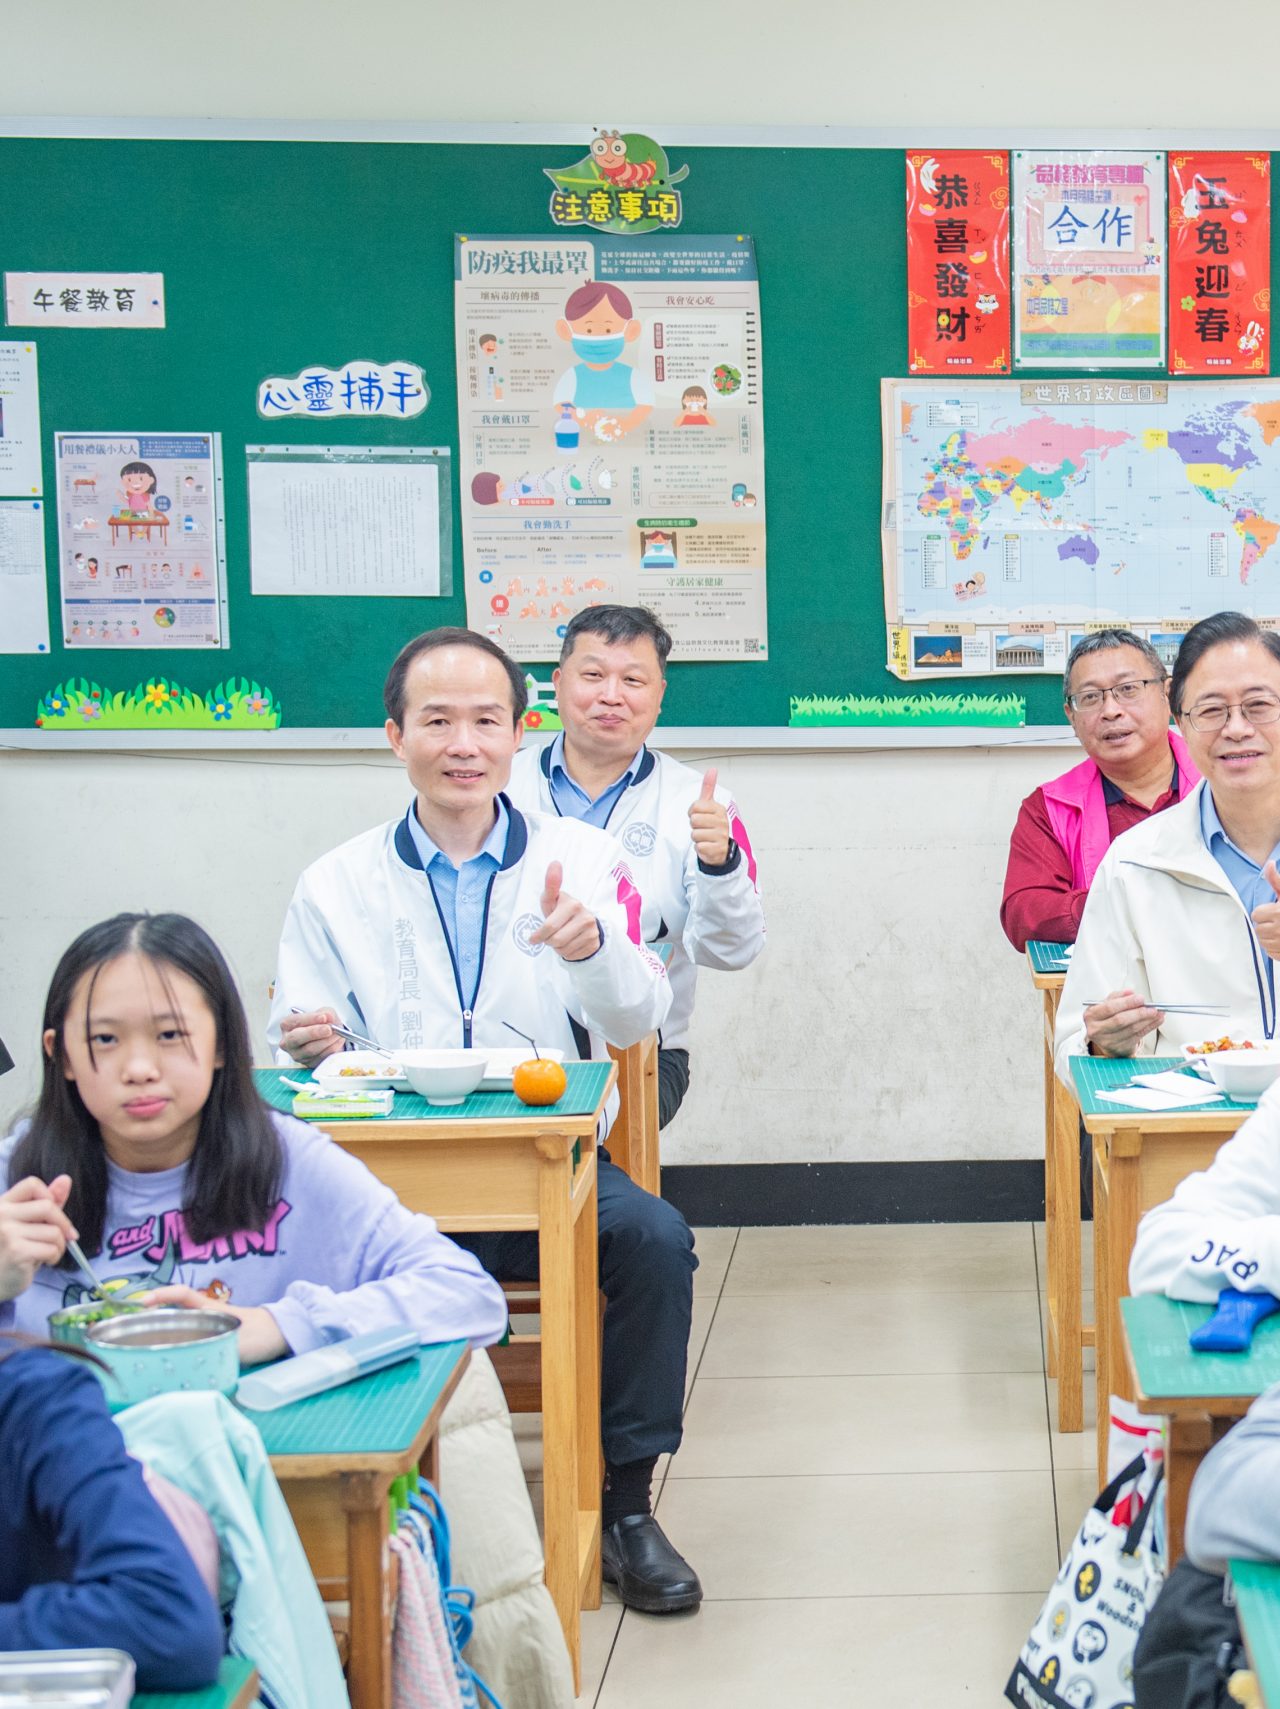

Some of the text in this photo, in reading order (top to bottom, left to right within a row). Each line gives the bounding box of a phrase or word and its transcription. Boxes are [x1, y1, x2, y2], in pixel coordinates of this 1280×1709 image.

[553, 191, 678, 222] 注意事項
[1047, 204, 1133, 247] 合作
[467, 250, 589, 275] 防疫我最罩
[934, 174, 970, 342] 恭喜發財
[1194, 176, 1230, 343] 玉兔迎春
[32, 288, 136, 313] 午餐教育
[665, 296, 716, 306] 我會安心吃
[263, 371, 420, 413] 心靈捕手
[1035, 384, 1154, 402] 世界行政區圖
[481, 415, 531, 425] 我會戴口罩
[64, 443, 137, 455] 用餐禮儀小大人
[523, 519, 573, 530] 我會勤洗手
[665, 577, 724, 588] 守護居家健康
[395, 918, 422, 1001] 教育局長
